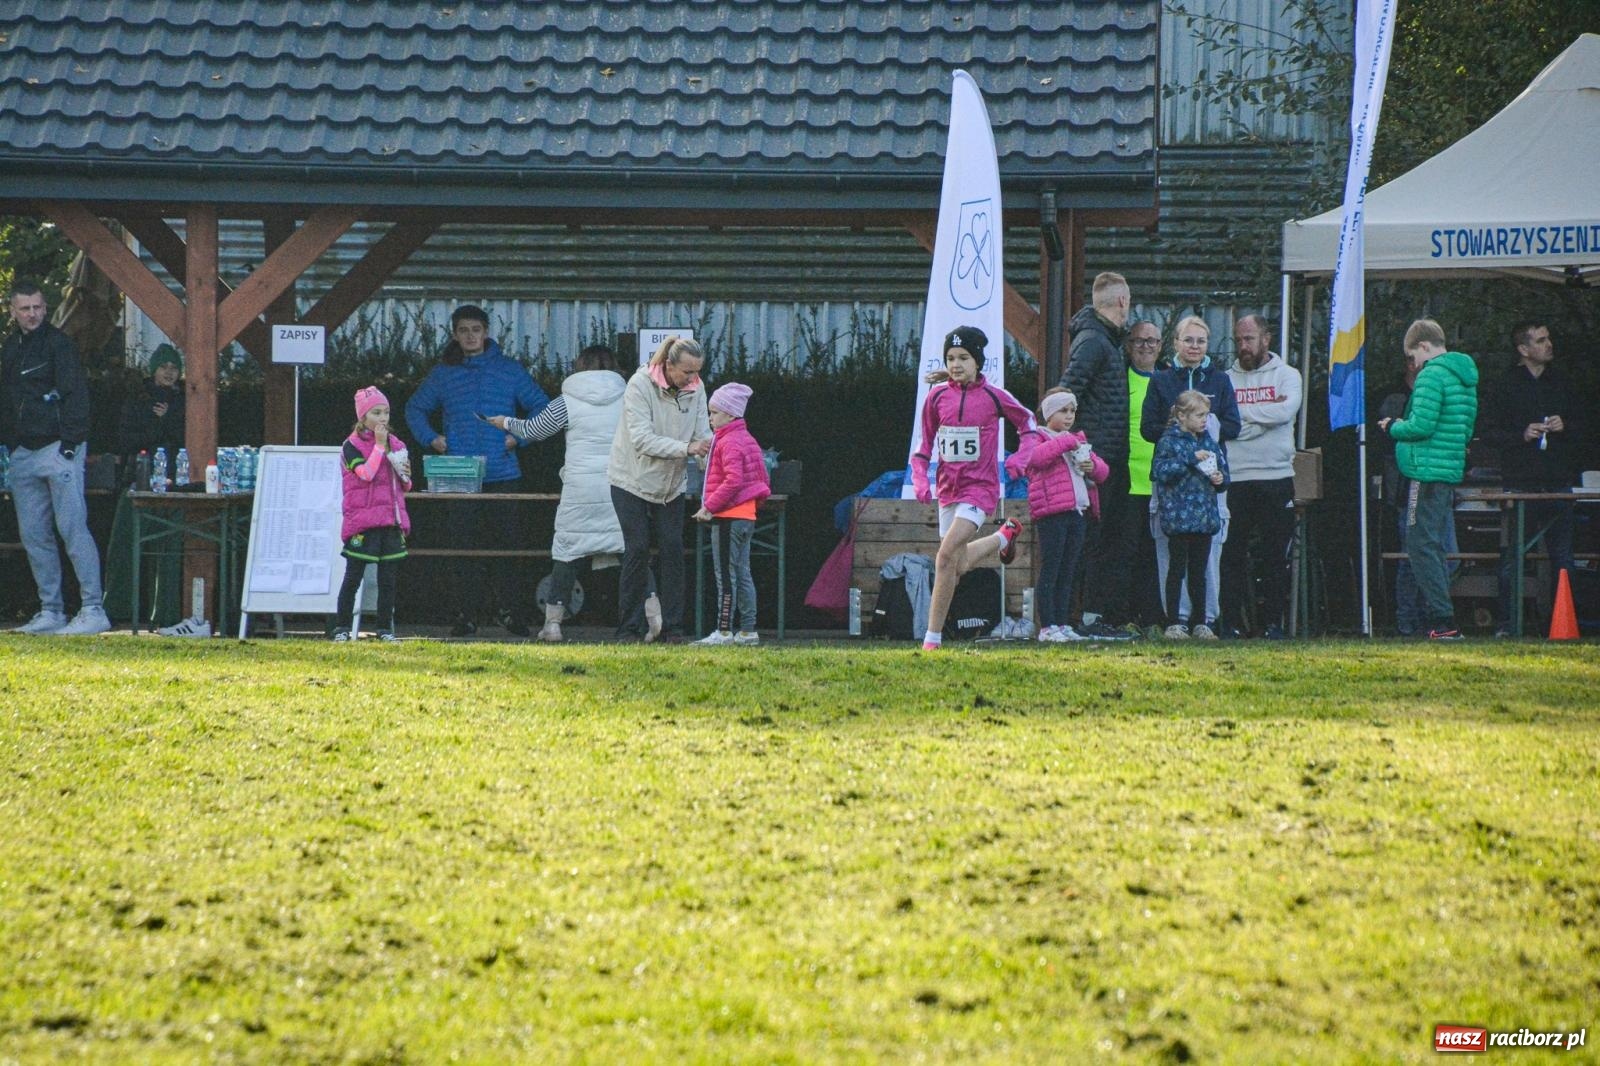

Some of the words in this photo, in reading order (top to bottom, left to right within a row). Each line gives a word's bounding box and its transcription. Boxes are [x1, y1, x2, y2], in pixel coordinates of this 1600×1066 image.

[280, 329, 318, 340] ZAPISY
[952, 334, 962, 346] LA
[940, 438, 977, 455] 115
